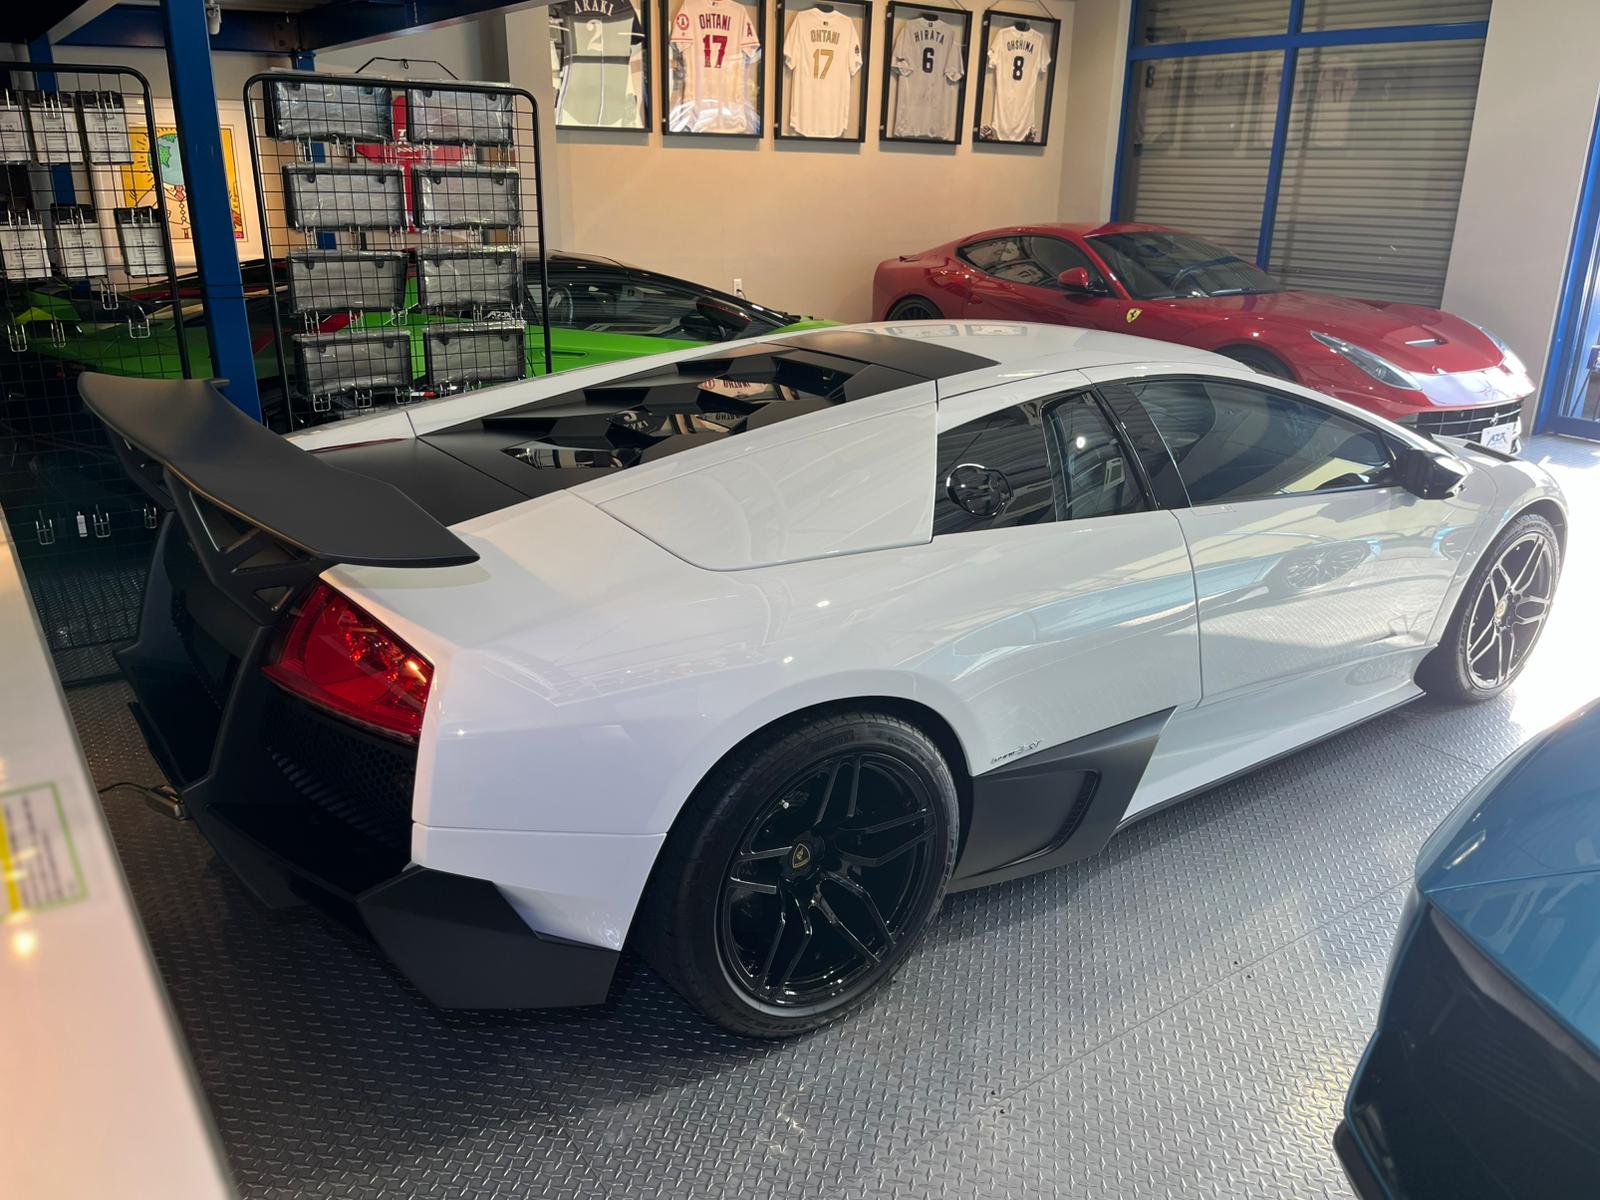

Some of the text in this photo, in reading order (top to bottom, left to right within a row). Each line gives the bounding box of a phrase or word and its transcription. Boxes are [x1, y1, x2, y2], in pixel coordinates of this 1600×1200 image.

[574, 0, 614, 16] ARAKI
[699, 13, 731, 31] OHTANI
[586, 19, 603, 51] 2
[810, 29, 841, 45] OHTANI
[914, 29, 945, 45] HIRATA
[702, 34, 728, 68] 17
[1006, 40, 1034, 54] OHSHIMA
[812, 48, 834, 80] 17
[922, 47, 935, 73] 6
[1012, 56, 1024, 81] 8
